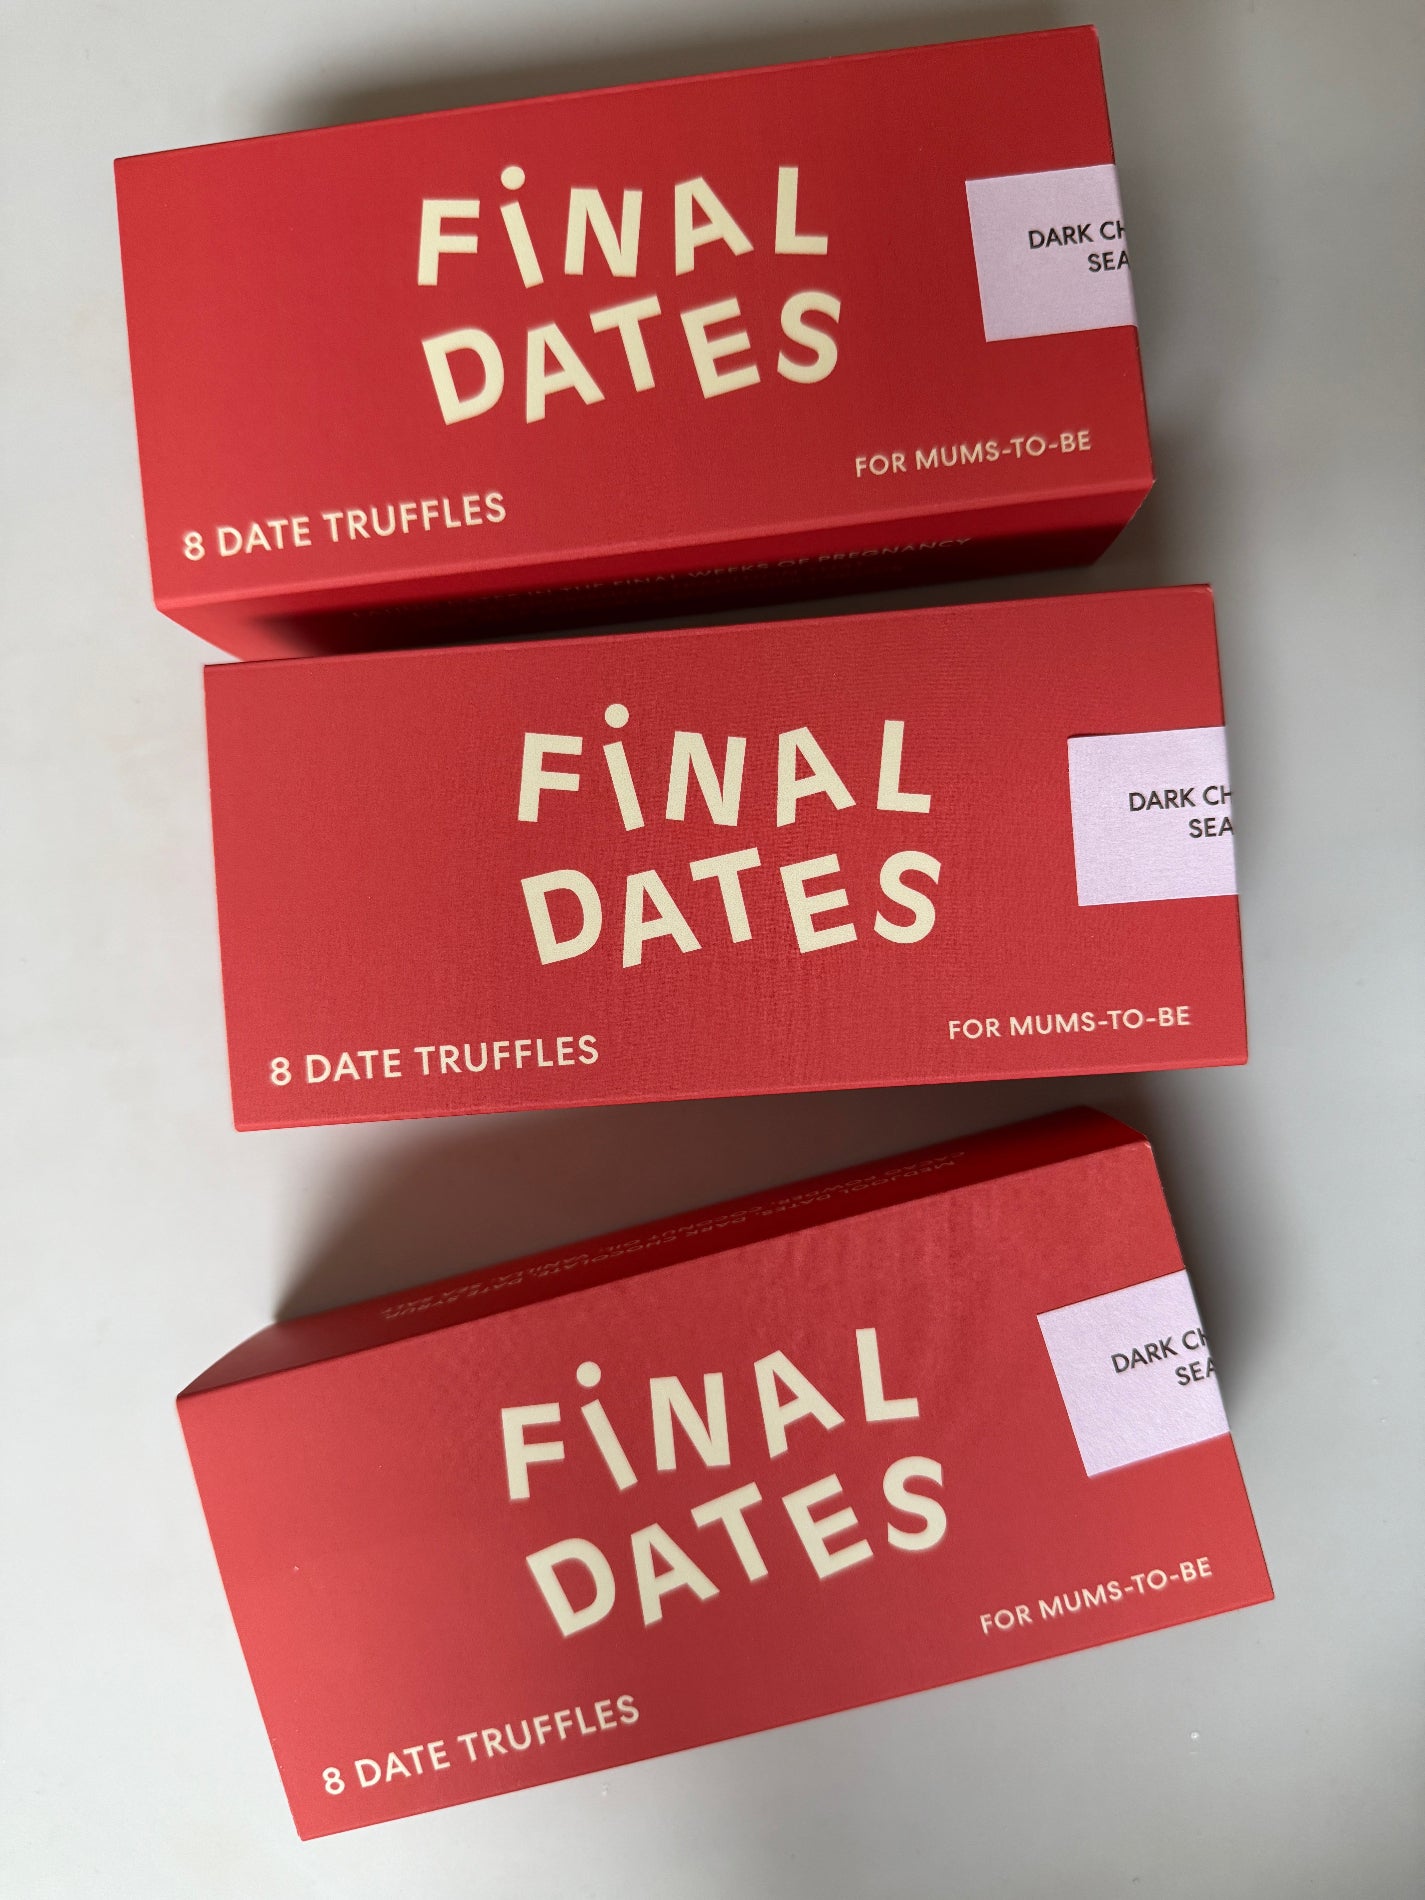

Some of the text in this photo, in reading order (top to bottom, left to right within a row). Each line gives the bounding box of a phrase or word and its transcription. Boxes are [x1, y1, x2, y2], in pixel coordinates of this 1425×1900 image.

[1028, 222, 1095, 251] DARK
[1087, 250, 1130, 274] SEA
[420, 289, 843, 427] DATES
[854, 430, 1093, 478] FOR MUMS-TO-BE
[182, 491, 506, 562] 8 DATE TRUFFLES
[612, 573, 679, 587] FINAL
[687, 563, 769, 578] WEEKS
[777, 558, 809, 567] OF
[818, 537, 972, 562] PREGNANCY
[1128, 787, 1196, 812] DARK
[1188, 816, 1234, 839] SEA
[519, 845, 943, 970] DATES
[948, 1005, 1192, 1041] FOR MUMS-TO-BE
[269, 1033, 599, 1087] 8 DATE TRUFFLES
[837, 1160, 956, 1195] MEDJOOL
[646, 1206, 763, 1240] COCONUT
[684, 1217, 746, 1236] DARK
[1110, 1336, 1178, 1374] DARK
[1175, 1356, 1217, 1386] SEA
[524, 1455, 948, 1639] DATES
[979, 1556, 1214, 1634] FOR MUMS-TO-BE
[321, 1694, 640, 1797] 8 DATE TRUFFLES
